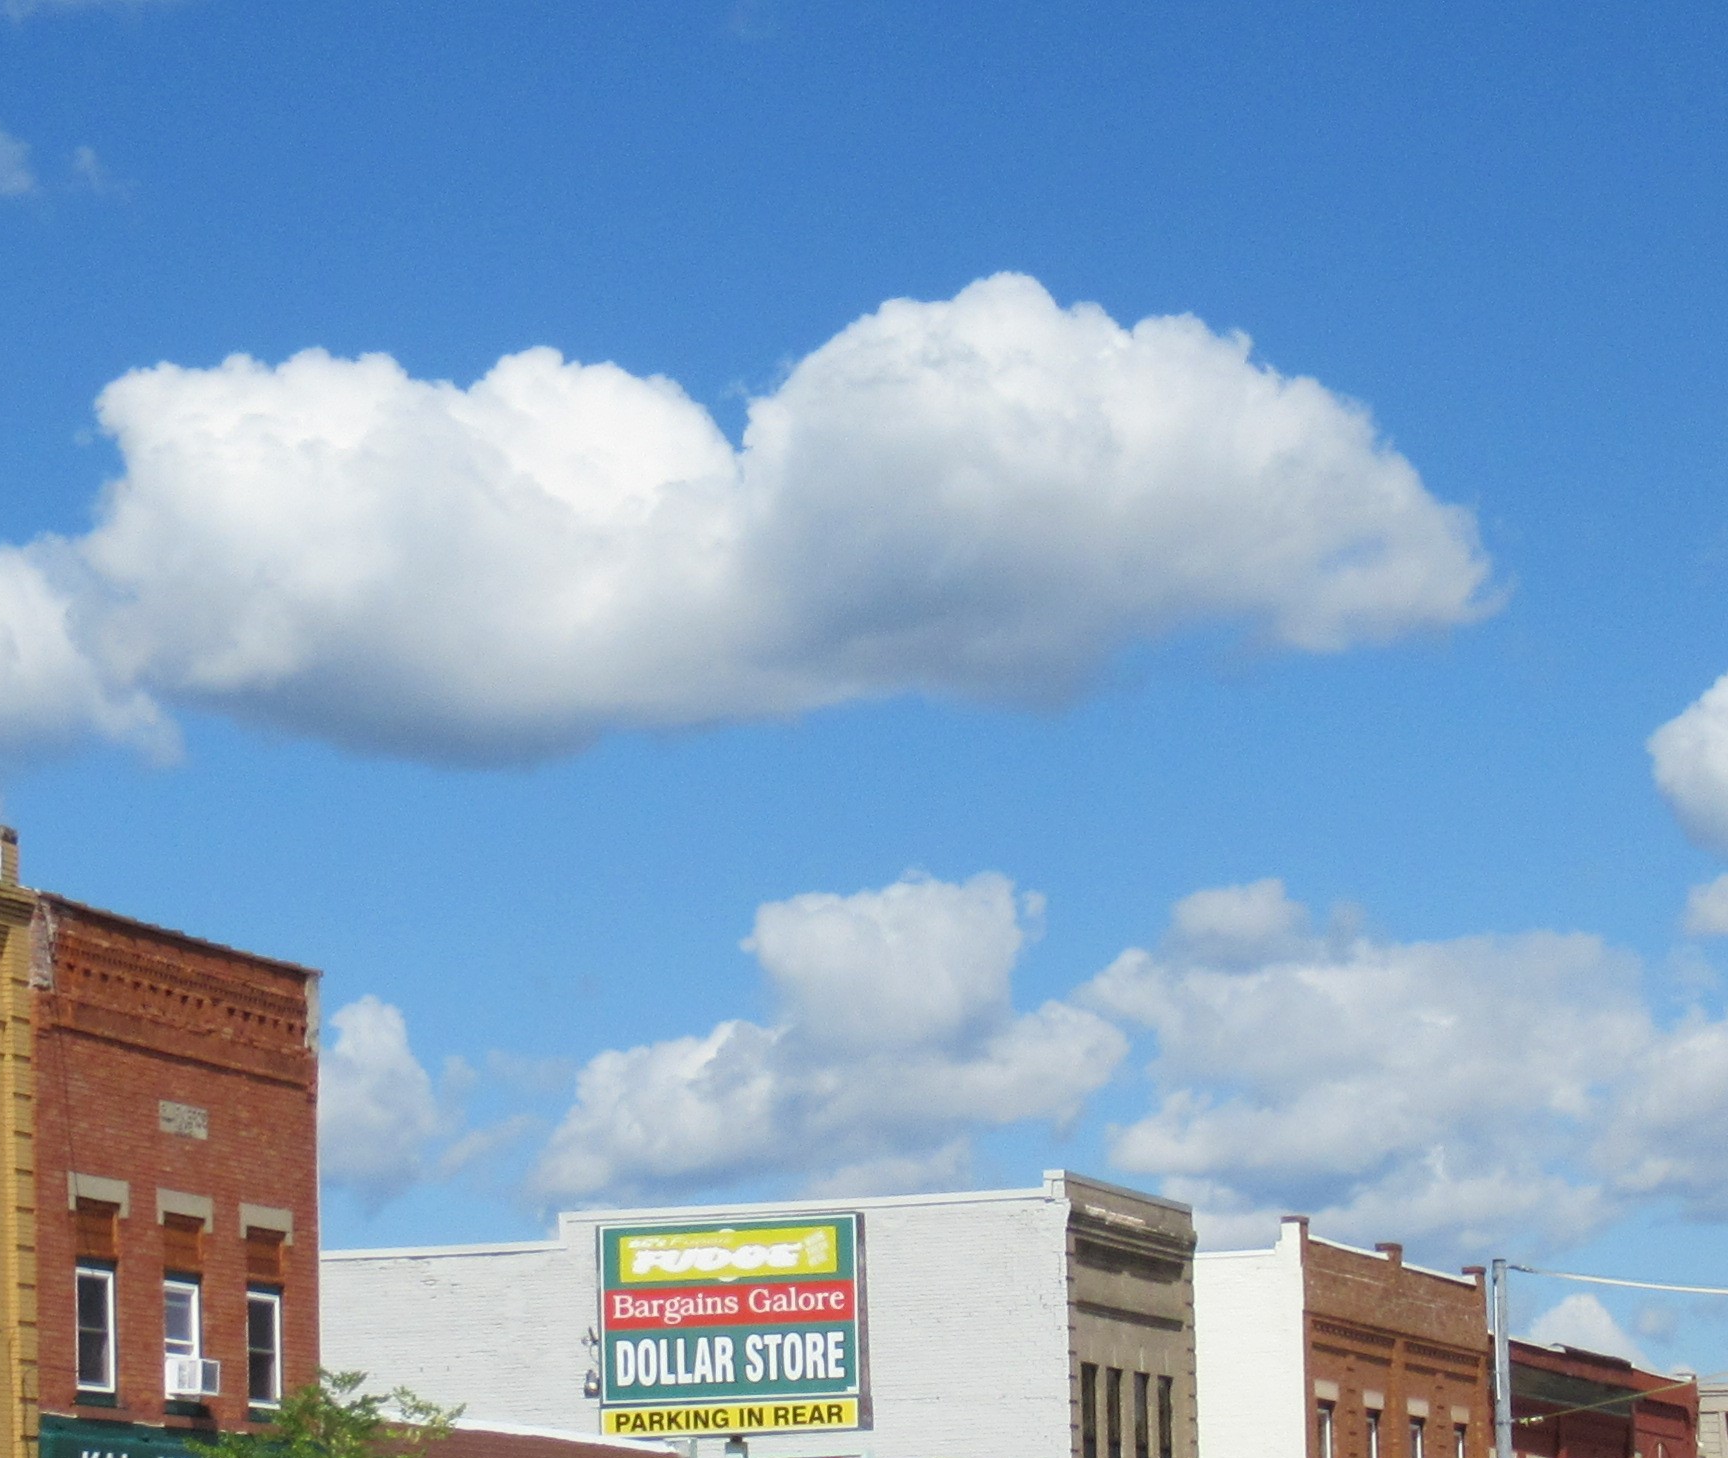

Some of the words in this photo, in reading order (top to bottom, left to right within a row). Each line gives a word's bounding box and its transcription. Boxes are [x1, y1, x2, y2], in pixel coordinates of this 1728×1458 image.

[631, 1242, 804, 1275] FUDGE
[613, 1293, 739, 1325] Bargains
[748, 1287, 846, 1314] Galore
[615, 1336, 735, 1387] DOLLAR
[744, 1331, 845, 1383] STORE
[615, 1408, 729, 1433] PARKING
[739, 1406, 764, 1428] IN
[774, 1404, 843, 1426] REAR
